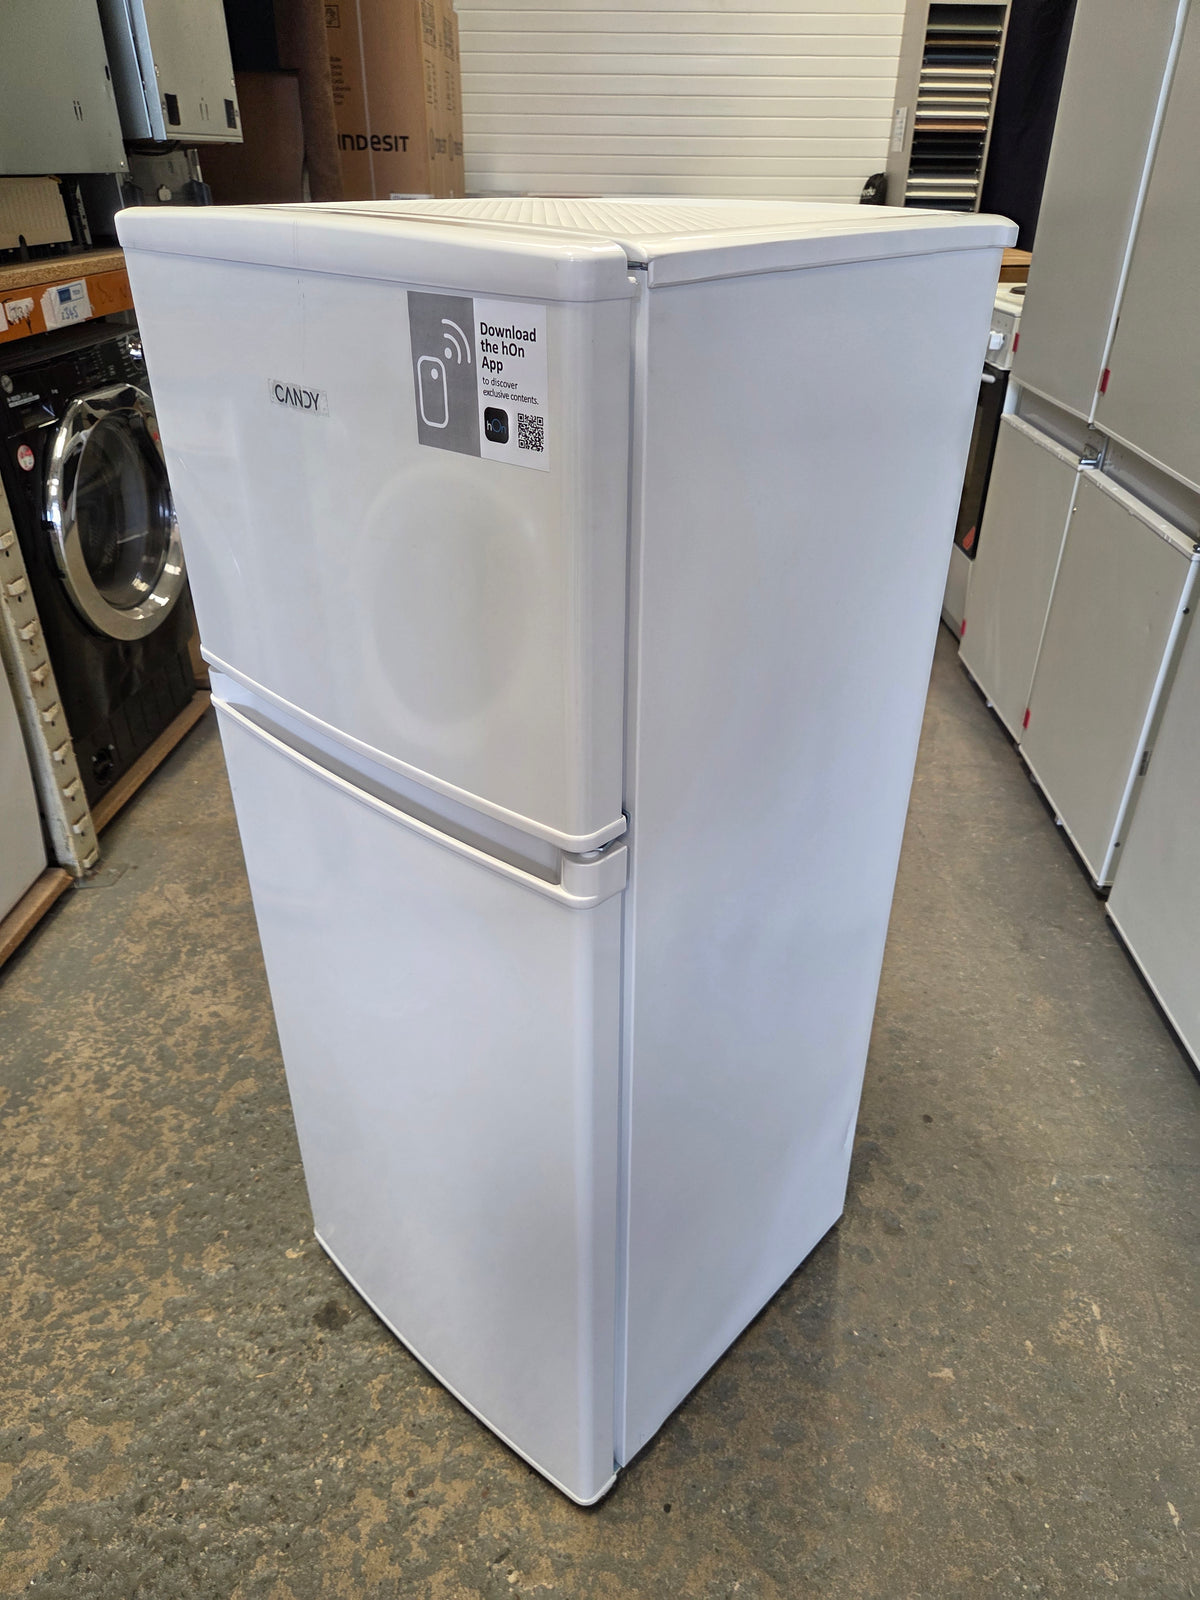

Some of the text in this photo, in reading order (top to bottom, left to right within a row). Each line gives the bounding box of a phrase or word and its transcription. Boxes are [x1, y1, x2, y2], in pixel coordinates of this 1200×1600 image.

[480, 322, 536, 342] Download
[480, 338, 525, 358] the hOn
[481, 356, 504, 374] App
[482, 376, 518, 390] to discover
[274, 383, 320, 411] CANDY
[482, 389, 539, 405] exclusive contents.
